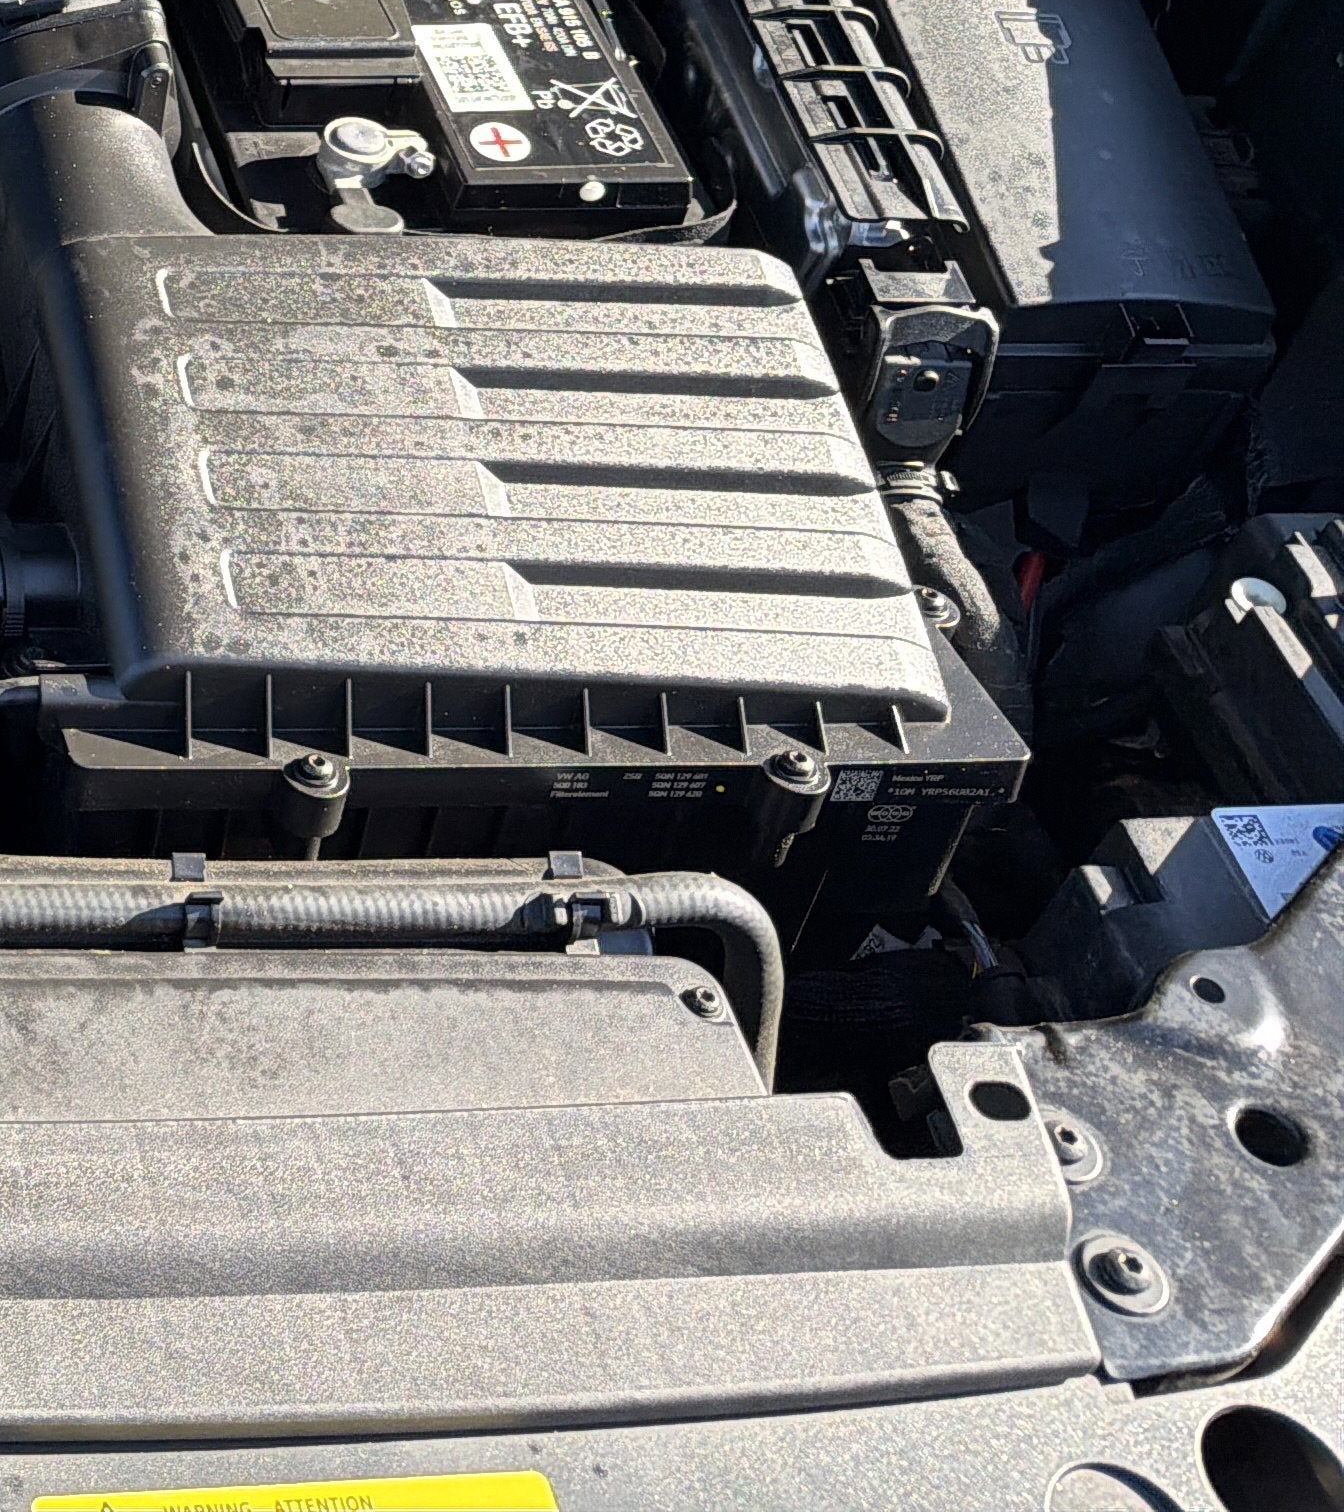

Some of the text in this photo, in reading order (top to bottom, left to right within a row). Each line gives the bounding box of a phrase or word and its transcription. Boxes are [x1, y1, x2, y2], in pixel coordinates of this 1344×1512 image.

[493, 2, 534, 49] EFB+
[558, 7, 583, 27] 915
[531, 89, 557, 111] Pb
[275, 1495, 373, 1512] ATTENTION
